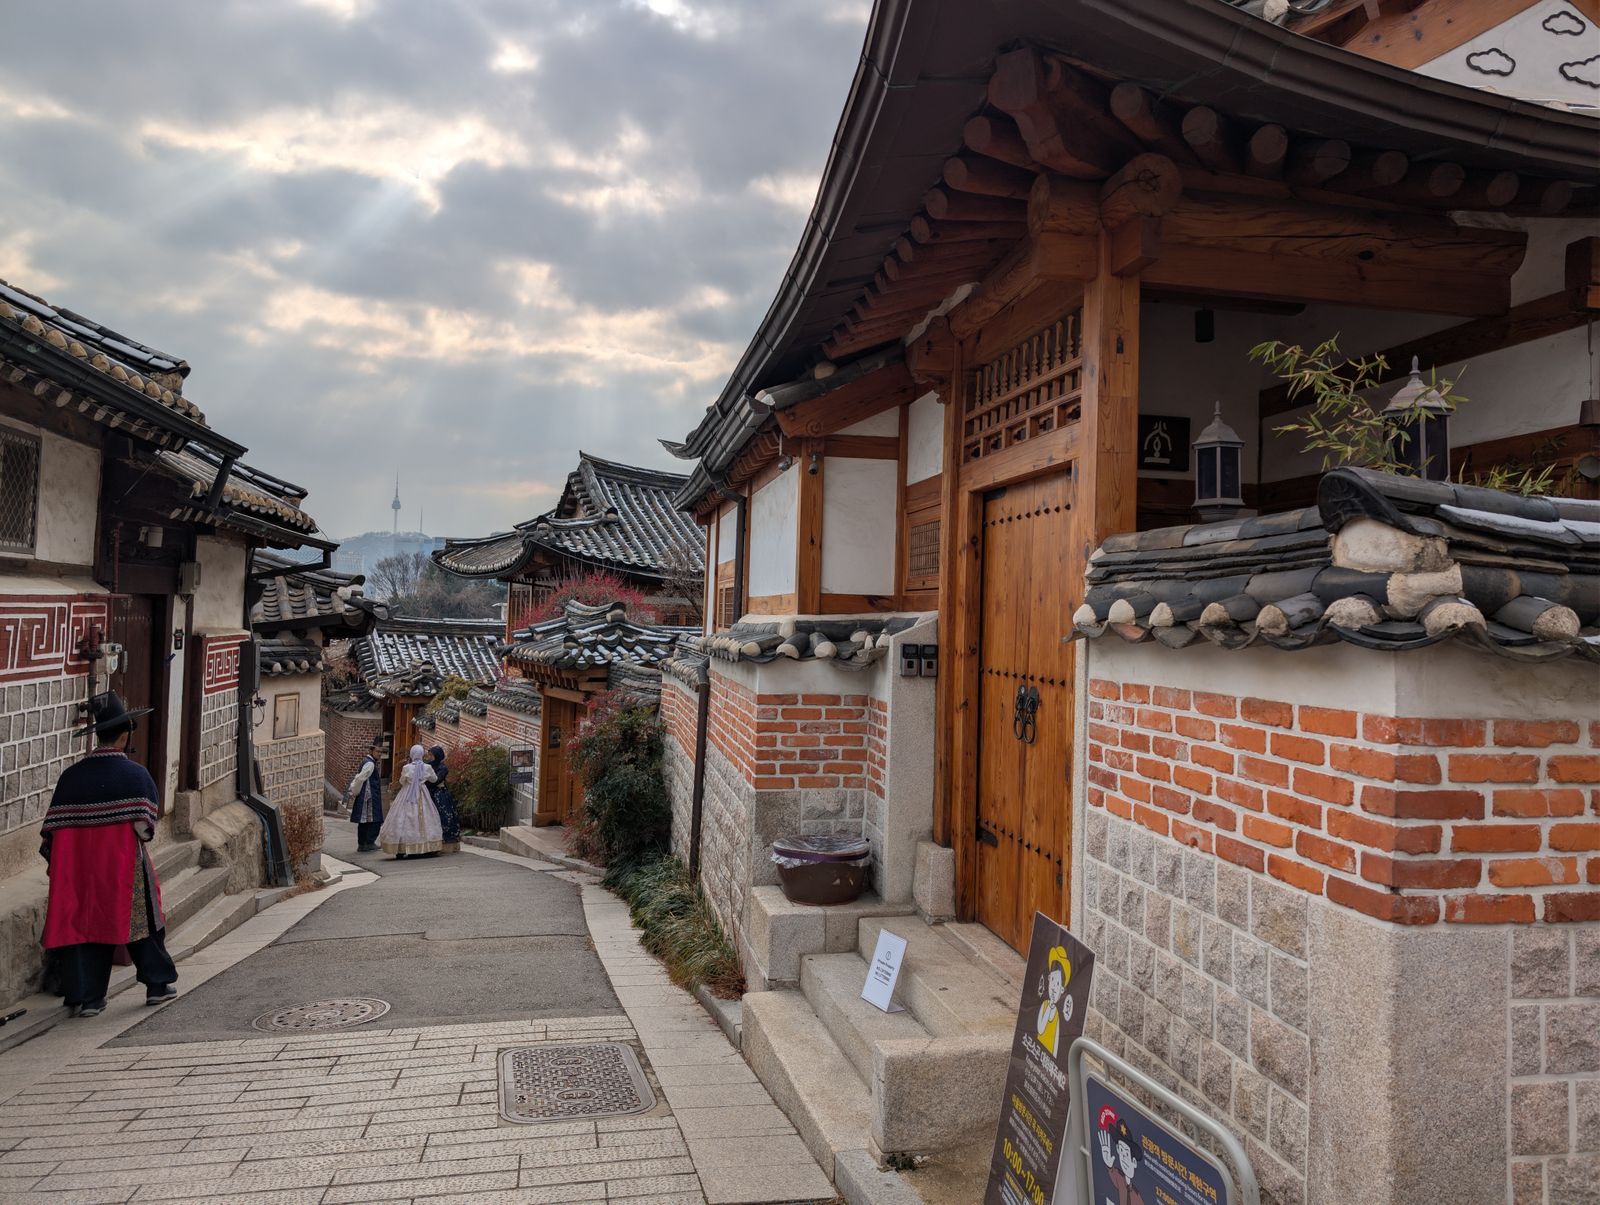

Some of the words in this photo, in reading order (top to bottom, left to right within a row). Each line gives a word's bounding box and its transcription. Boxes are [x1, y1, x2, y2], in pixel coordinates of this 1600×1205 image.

[1022, 1033, 1041, 1061] 소곤소곤
[1040, 1051, 1066, 1091] 대화해주세요
[1003, 1137, 1045, 1205] 10:00~17:00
[1141, 1134, 1160, 1161] 관광객
[1161, 1150, 1188, 1178] 방문시간
